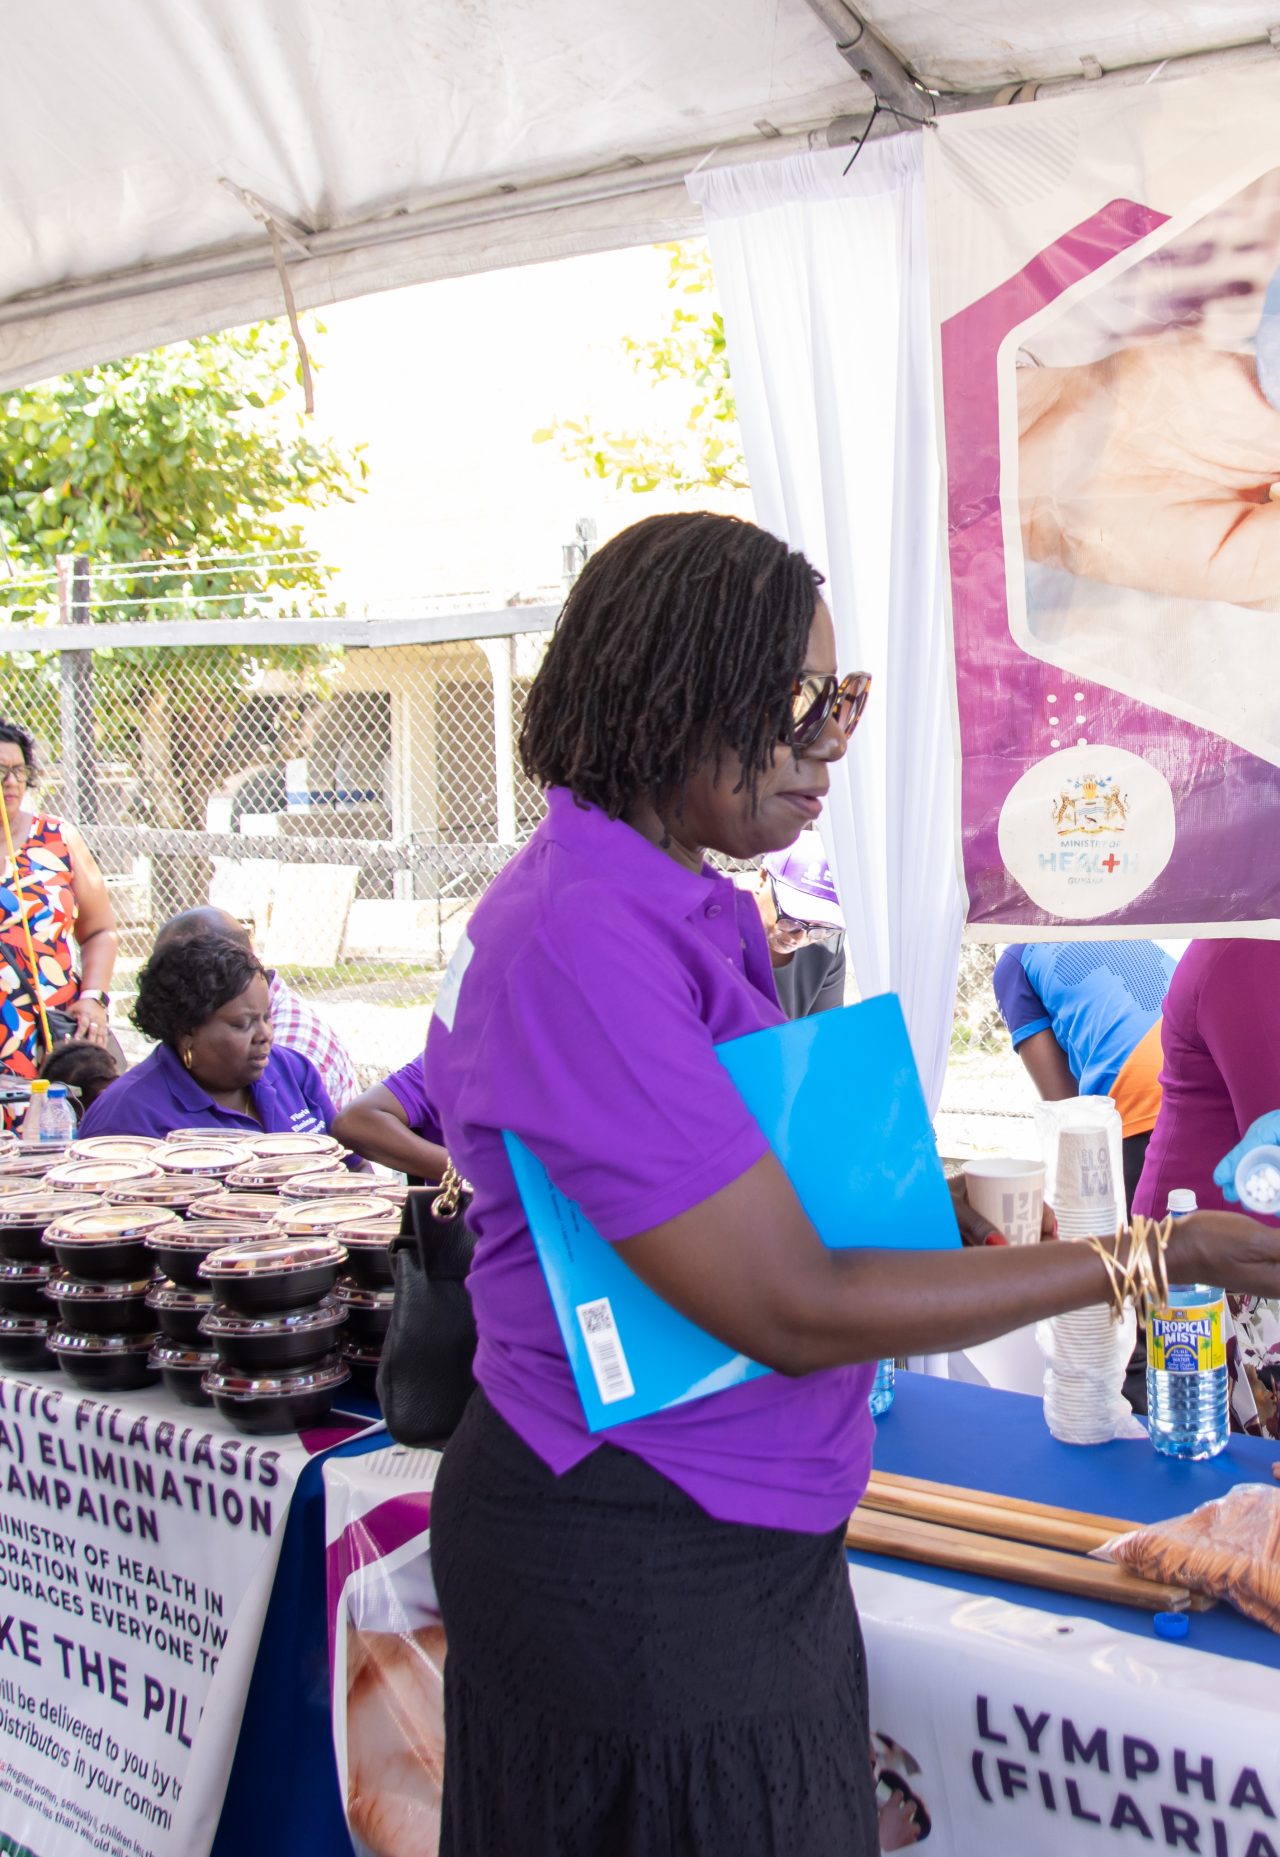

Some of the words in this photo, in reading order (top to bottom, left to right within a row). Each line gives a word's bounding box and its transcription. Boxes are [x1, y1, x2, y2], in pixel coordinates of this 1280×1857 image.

[1153, 1318, 1211, 1337] TROPICAL
[1165, 1332, 1198, 1347] MIST
[75, 1399, 281, 1488] FILARIASIS
[0, 1463, 159, 1543] AMPAIGN
[38, 1432, 273, 1537] ELIMINATION
[84, 1544, 109, 1569] OF
[118, 1554, 196, 1605] HEALTH
[204, 1588, 223, 1617] IN
[85, 1571, 138, 1610] WITH
[146, 1594, 228, 1650] PAHO/W
[91, 1601, 193, 1665] EVERYONE
[53, 1633, 129, 1708] THE
[143, 1672, 203, 1750] PIL
[0, 1678, 15, 1705] ill
[18, 1685, 36, 1714] be
[40, 1697, 103, 1752] delivered
[106, 1735, 119, 1761] to
[121, 1748, 148, 1780] you
[152, 1761, 170, 1798] by
[74, 1749, 86, 1778] in
[86, 1764, 122, 1798] your
[55, 1811, 74, 1831] than
[94, 1837, 109, 1852] old
[100, 1822, 132, 1849] children
